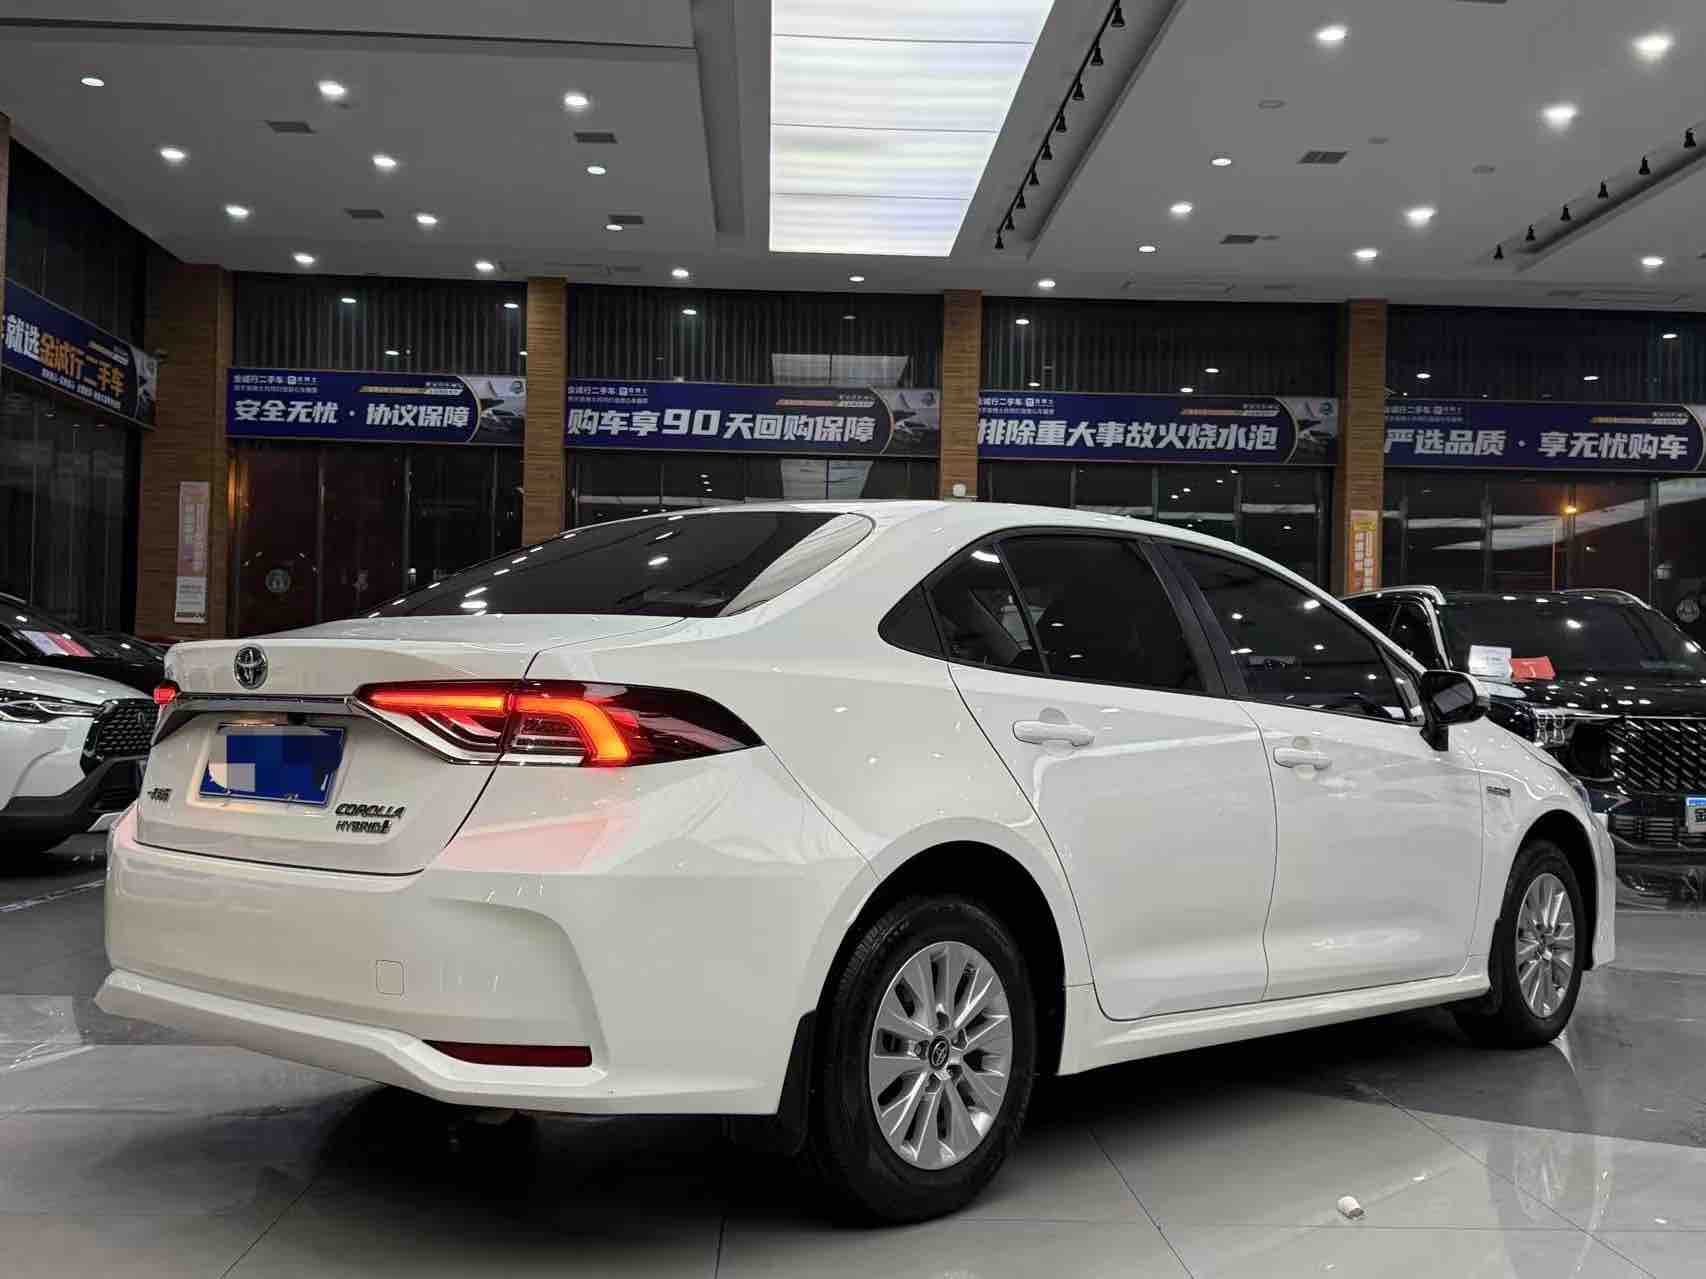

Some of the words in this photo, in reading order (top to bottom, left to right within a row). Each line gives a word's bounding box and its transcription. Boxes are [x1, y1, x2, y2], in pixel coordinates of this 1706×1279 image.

[568, 408, 876, 442] 购车享90天回购保障
[978, 418, 1278, 450] 排除重大事故火烧水泡
[335, 803, 406, 819] COROLLA
